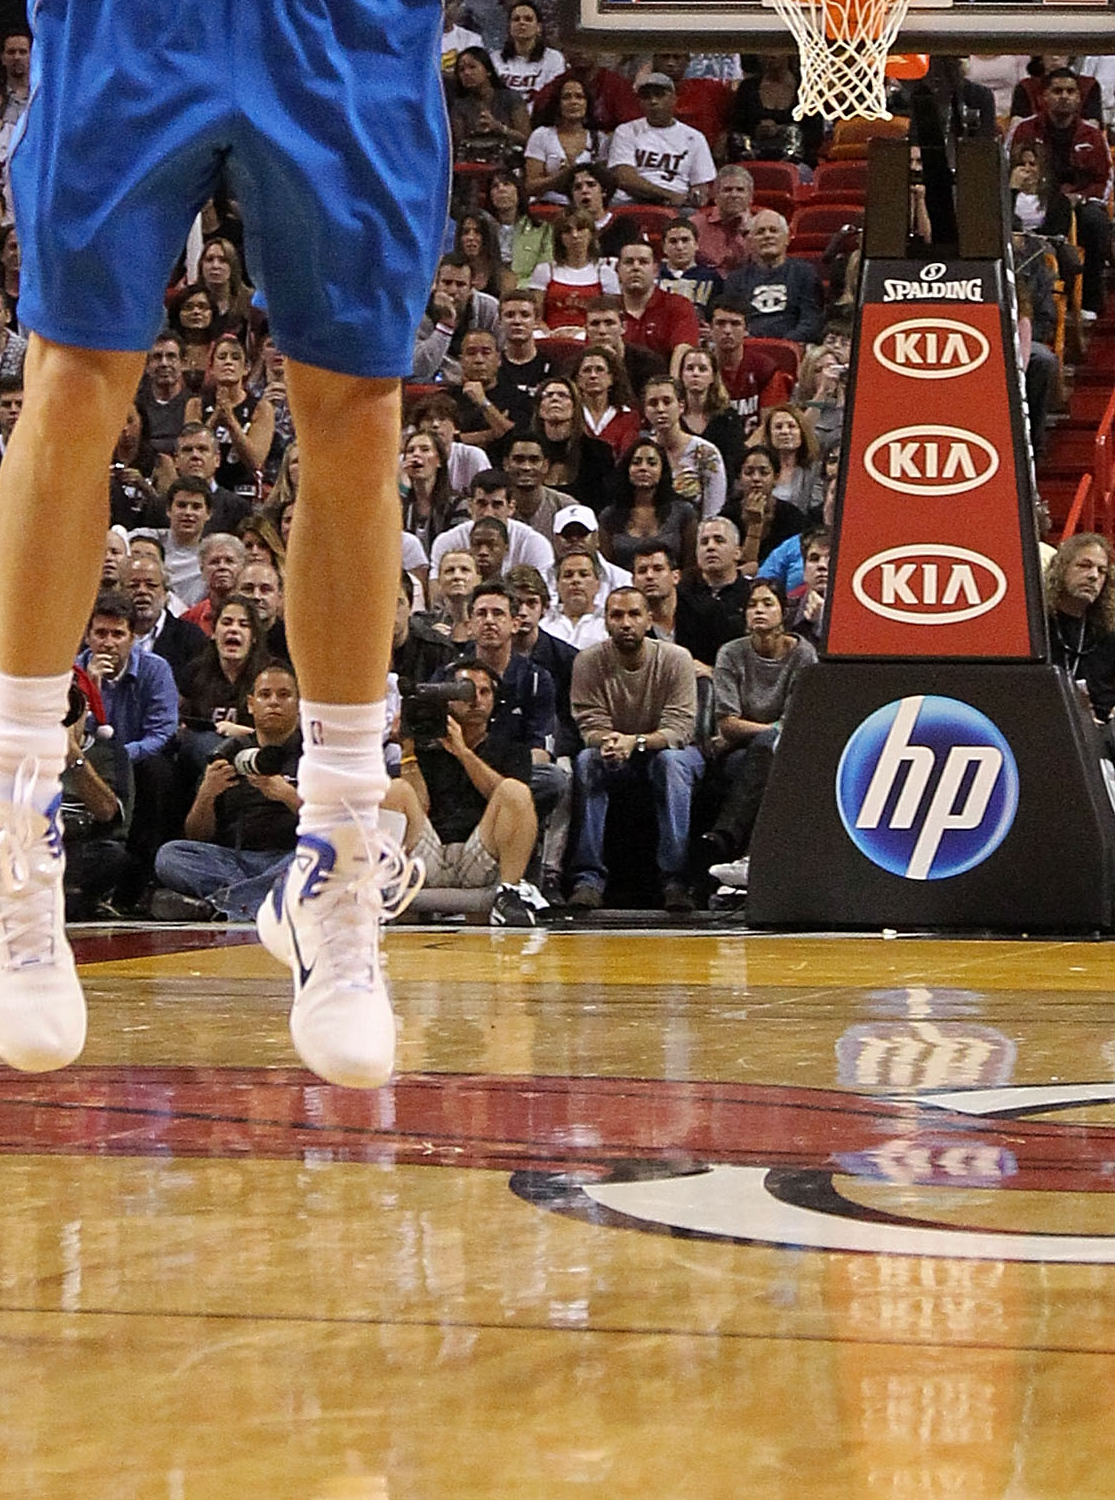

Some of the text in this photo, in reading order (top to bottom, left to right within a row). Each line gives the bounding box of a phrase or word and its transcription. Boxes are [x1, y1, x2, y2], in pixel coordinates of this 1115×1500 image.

[635, 149, 688, 170] HEAT
[883, 279, 984, 302] SPALDING
[895, 333, 971, 364] KIA
[889, 442, 978, 479] KIA
[881, 563, 982, 605] KIA
[856, 695, 1004, 880] hp
